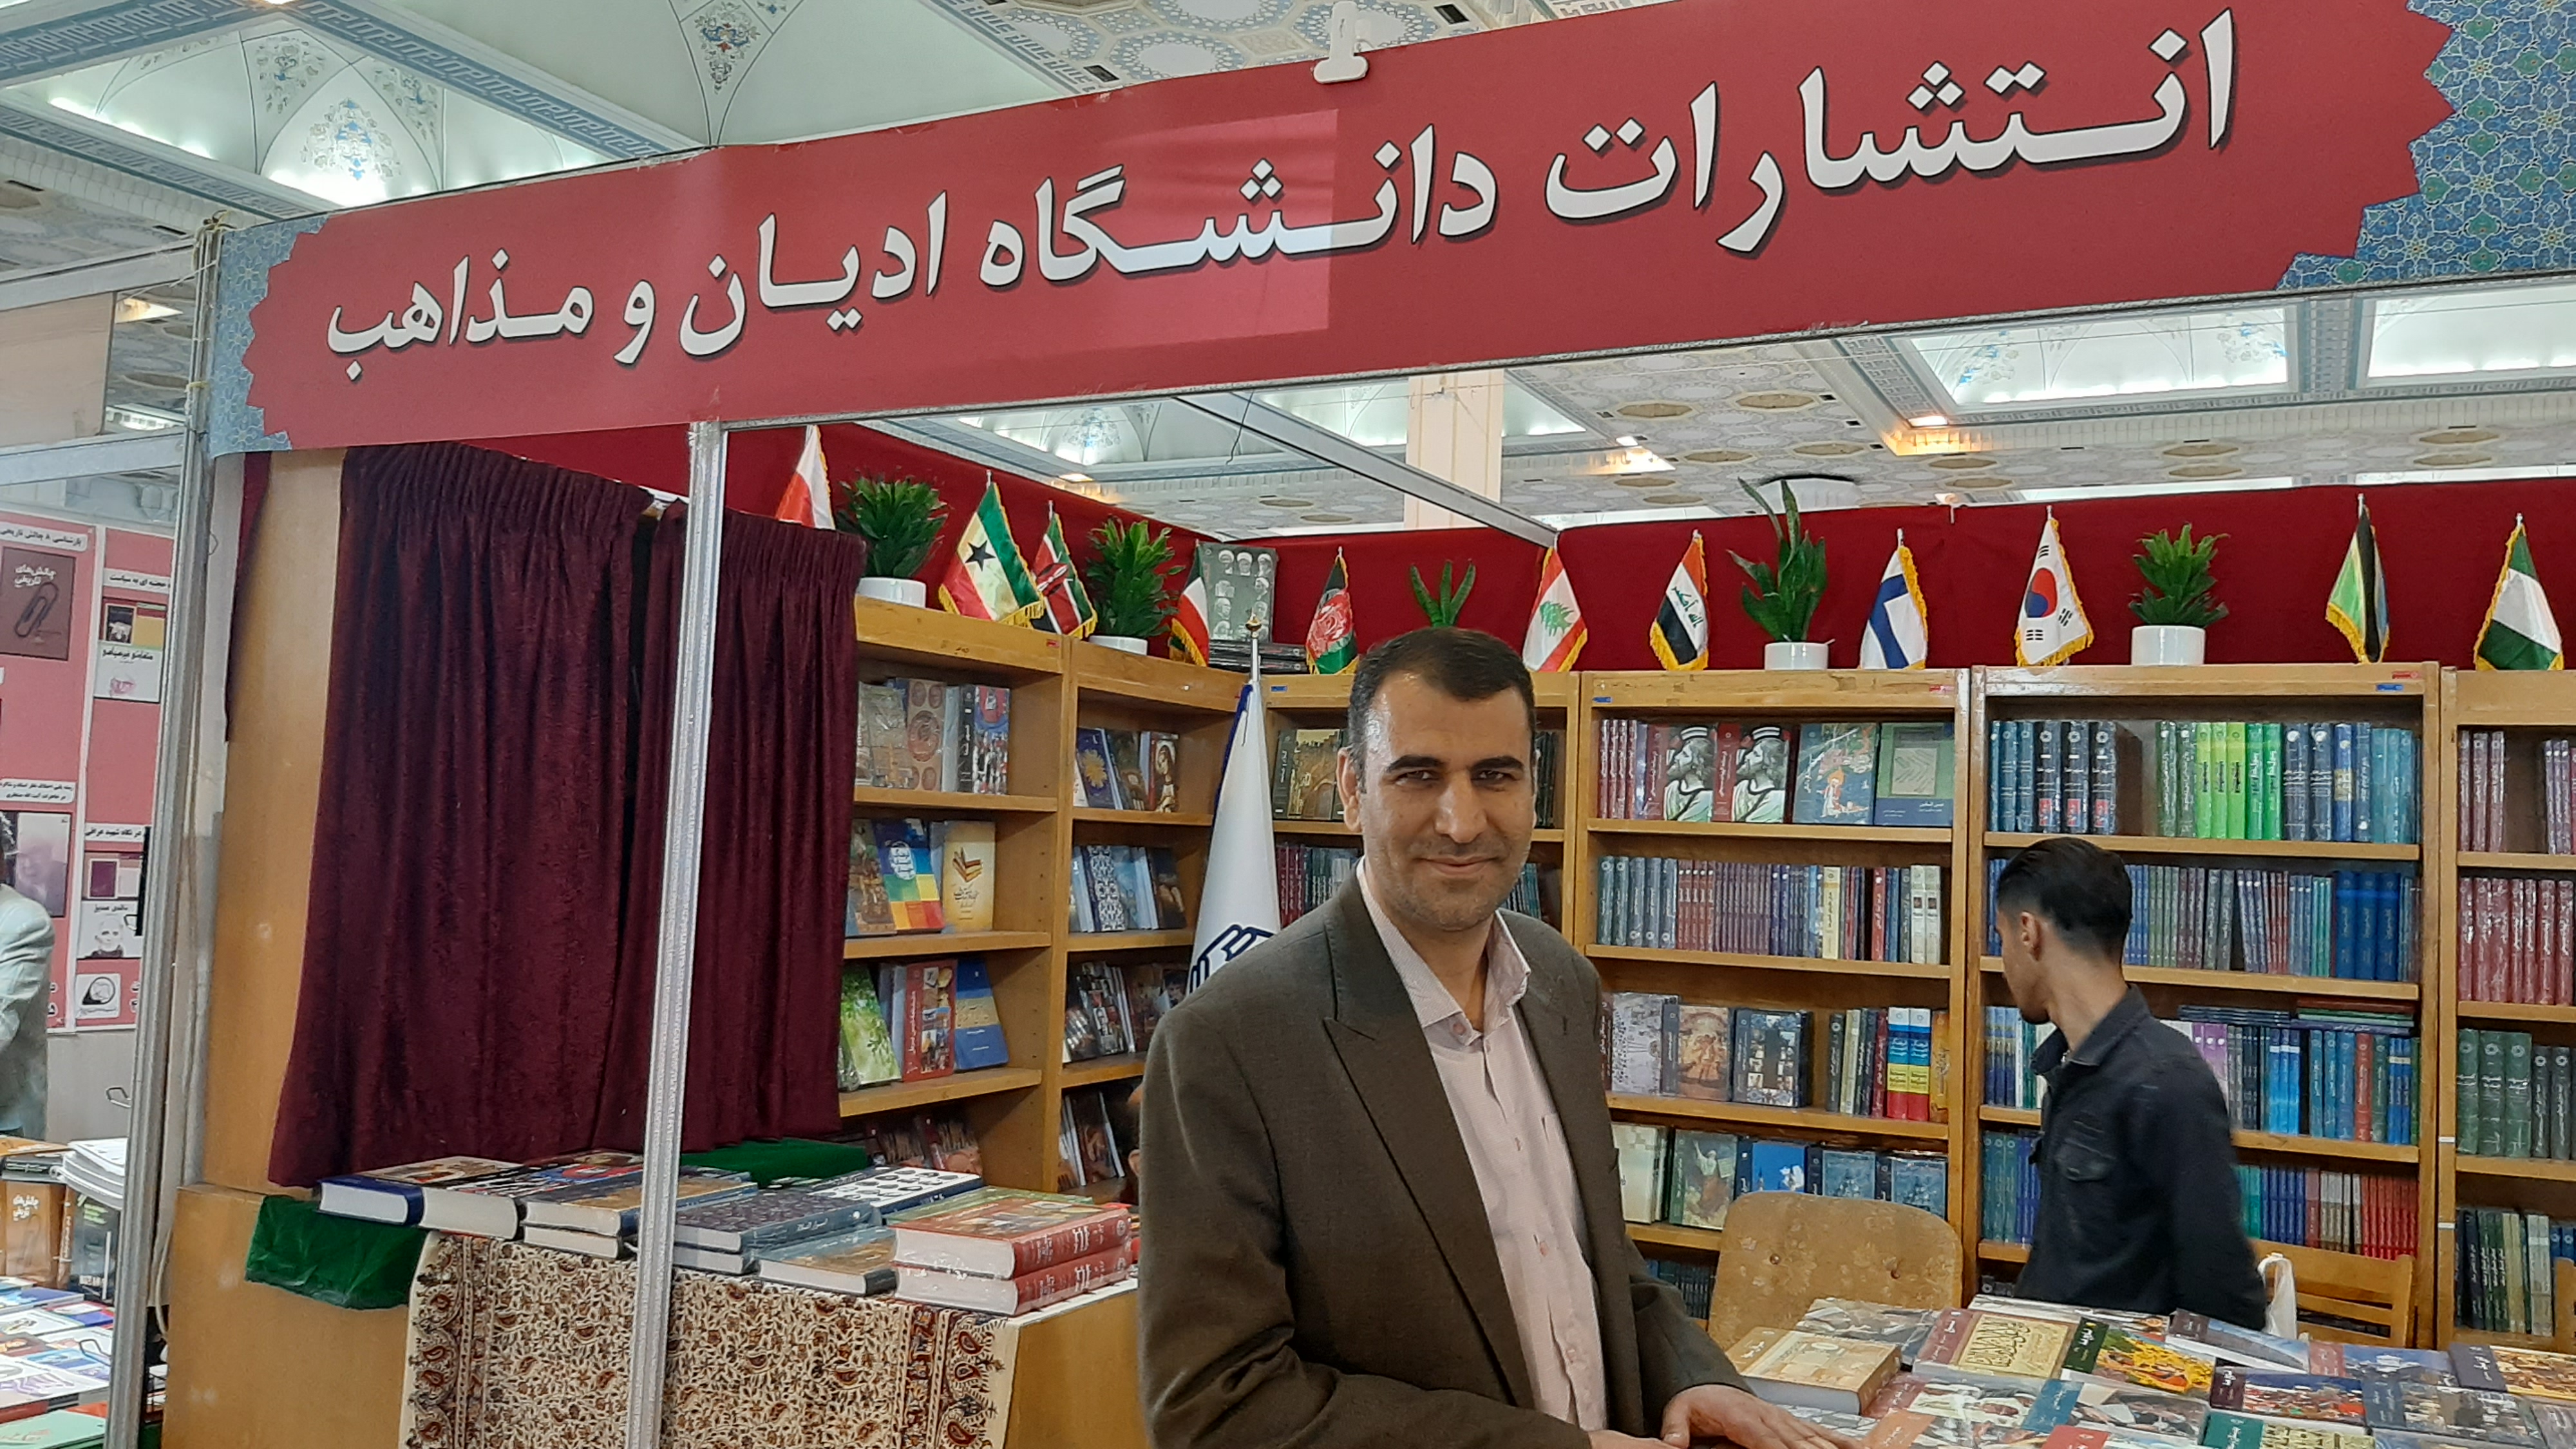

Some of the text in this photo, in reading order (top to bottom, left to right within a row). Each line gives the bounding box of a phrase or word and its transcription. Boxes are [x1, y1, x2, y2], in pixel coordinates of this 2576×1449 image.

[327, 8, 2238, 381] انتشارات دانشگاه ادیان و مذاهب
